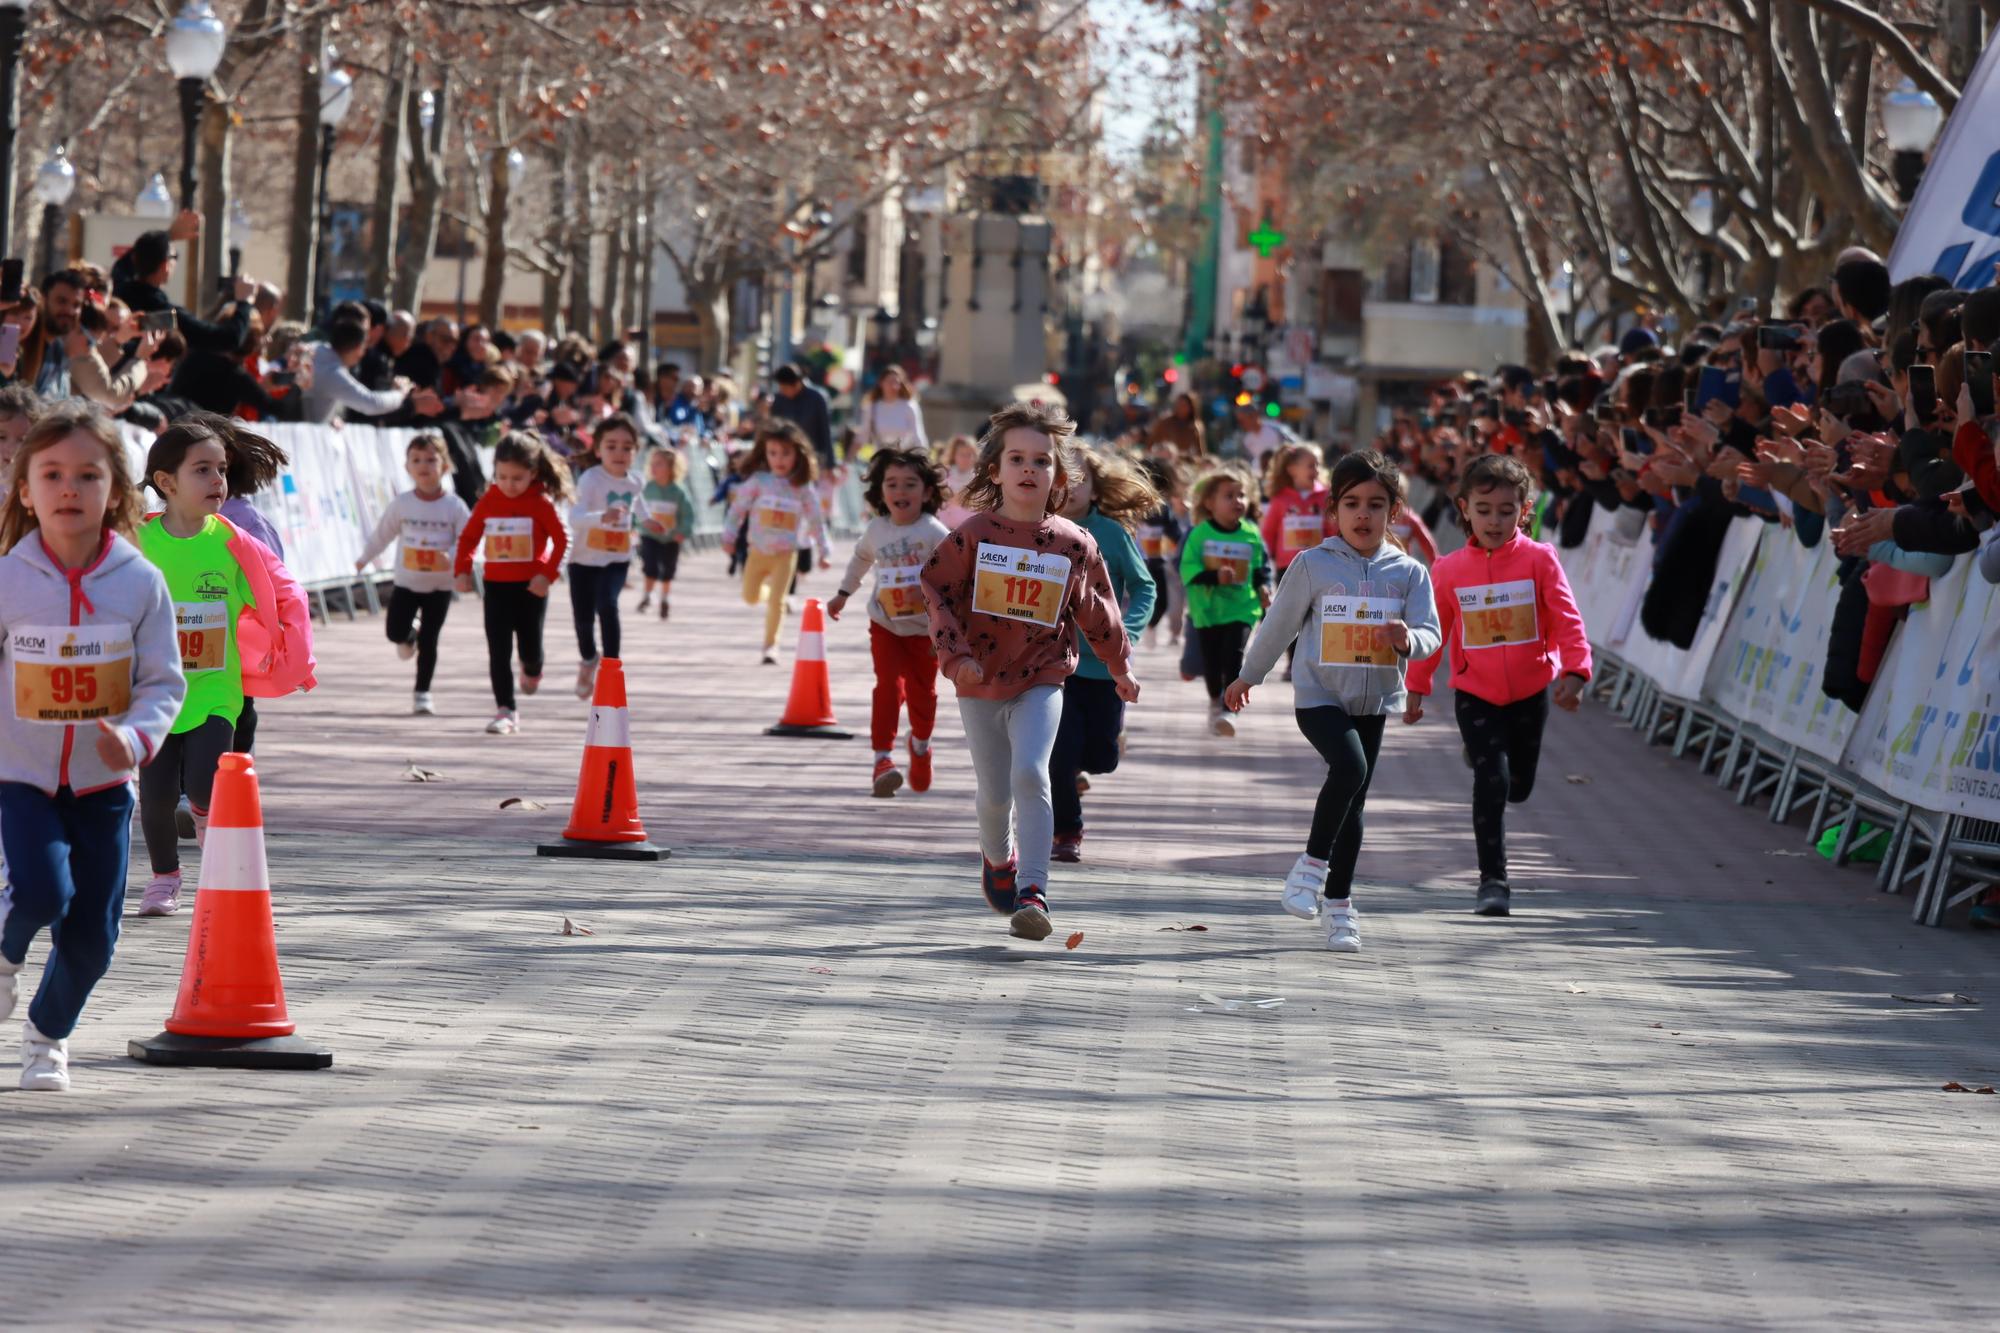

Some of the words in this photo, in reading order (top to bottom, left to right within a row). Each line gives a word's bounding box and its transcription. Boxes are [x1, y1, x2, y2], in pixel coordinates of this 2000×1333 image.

[1017, 560, 1044, 574] marató
[1003, 575, 1042, 607] 112
[176, 613, 203, 624] marató
[1007, 607, 1033, 618] CARMEN
[1355, 609, 1383, 620] marató
[60, 642, 101, 657] marató
[51, 665, 97, 704] 95
[38, 709, 79, 720] NICOLETA
